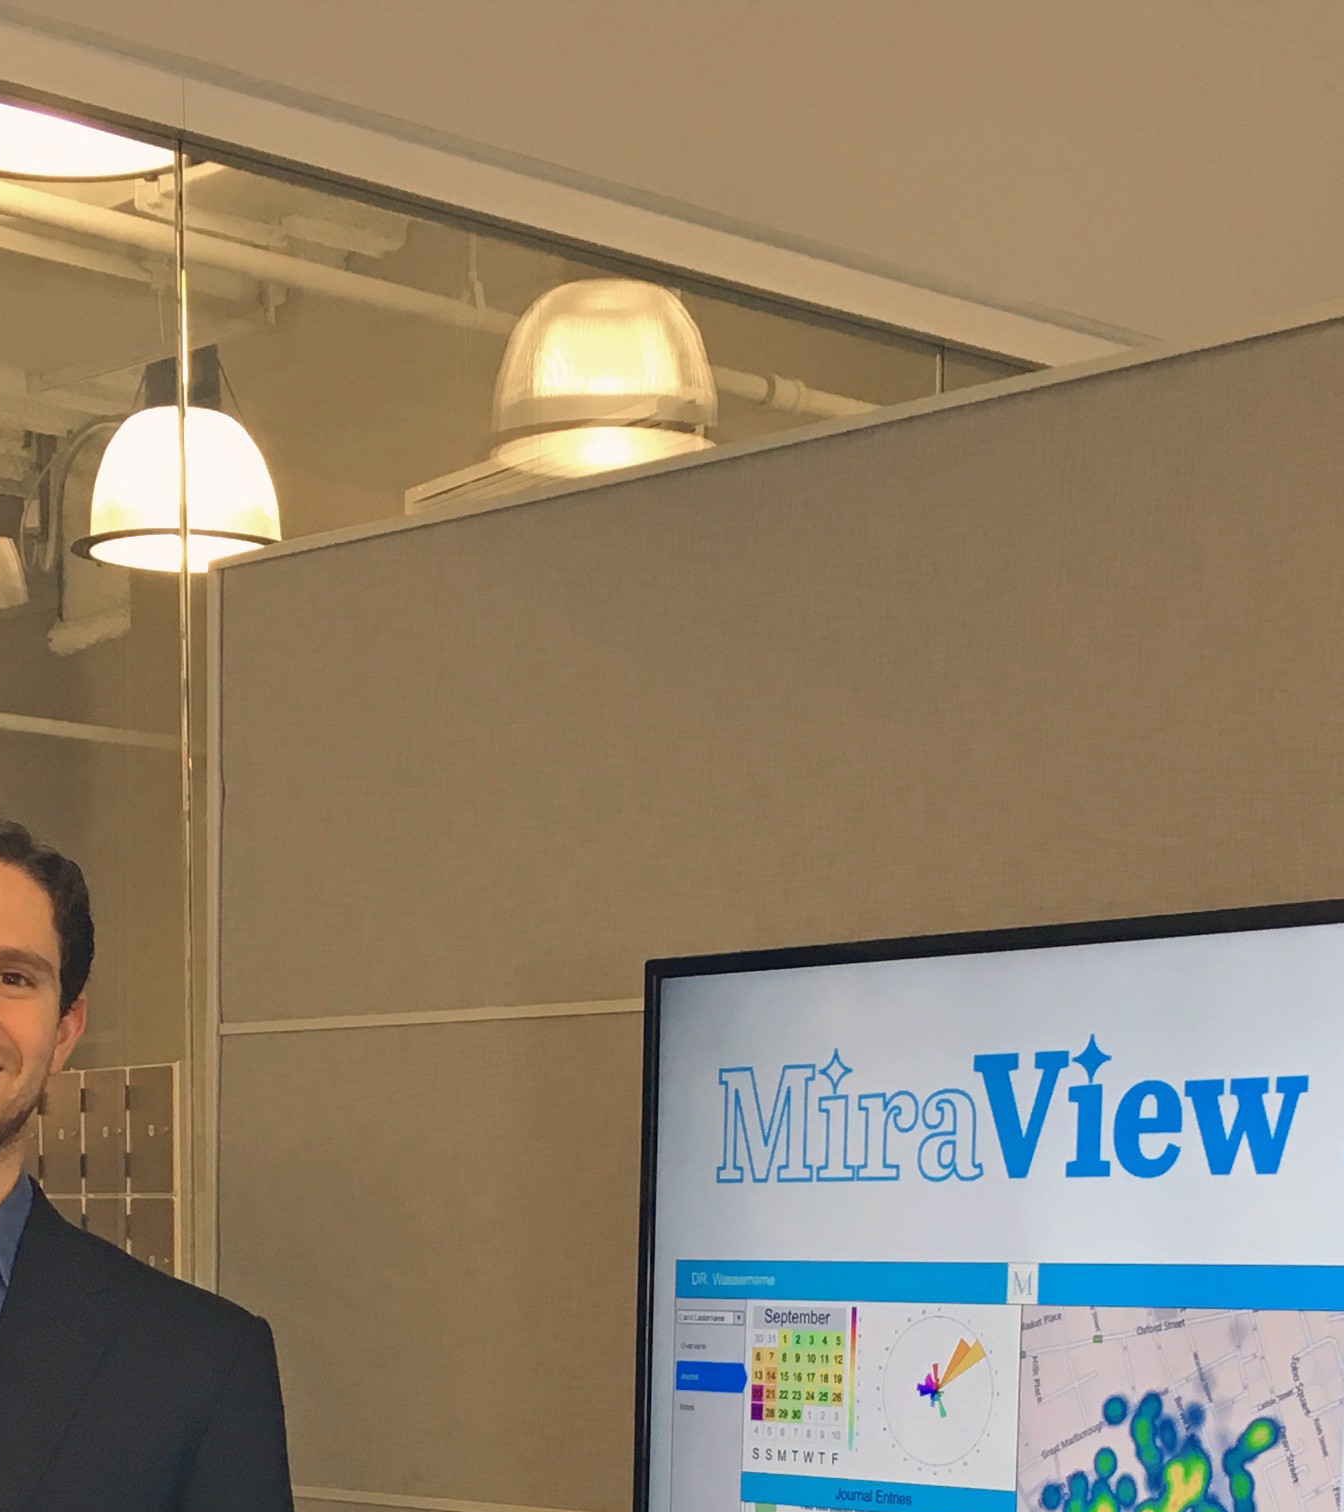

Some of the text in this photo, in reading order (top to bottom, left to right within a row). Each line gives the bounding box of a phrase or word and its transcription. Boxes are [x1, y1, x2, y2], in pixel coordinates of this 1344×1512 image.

[716, 1033, 1309, 1183] MiraView
[764, 1308, 831, 1326] September
[822, 1335, 828, 1345] 4
[835, 1336, 842, 1346] 5
[795, 1353, 801, 1363] 9
[807, 1353, 817, 1364] 10
[820, 1354, 829, 1364] 11
[834, 1354, 843, 1365] 12
[754, 1370, 843, 1383] 13 14 15 16 17 18 19
[766, 1389, 775, 1399] 21
[779, 1390, 788, 1400] 22
[792, 1390, 802, 1400] 23
[805, 1391, 815, 1401] 24
[818, 1391, 828, 1402] 25
[832, 1392, 842, 1402] 26
[765, 1408, 775, 1418] 28
[779, 1409, 788, 1419] 29
[792, 1409, 802, 1419] 30
[752, 1447, 839, 1465] S S M T W T F
[835, 1488, 913, 1506] Journal Entries
